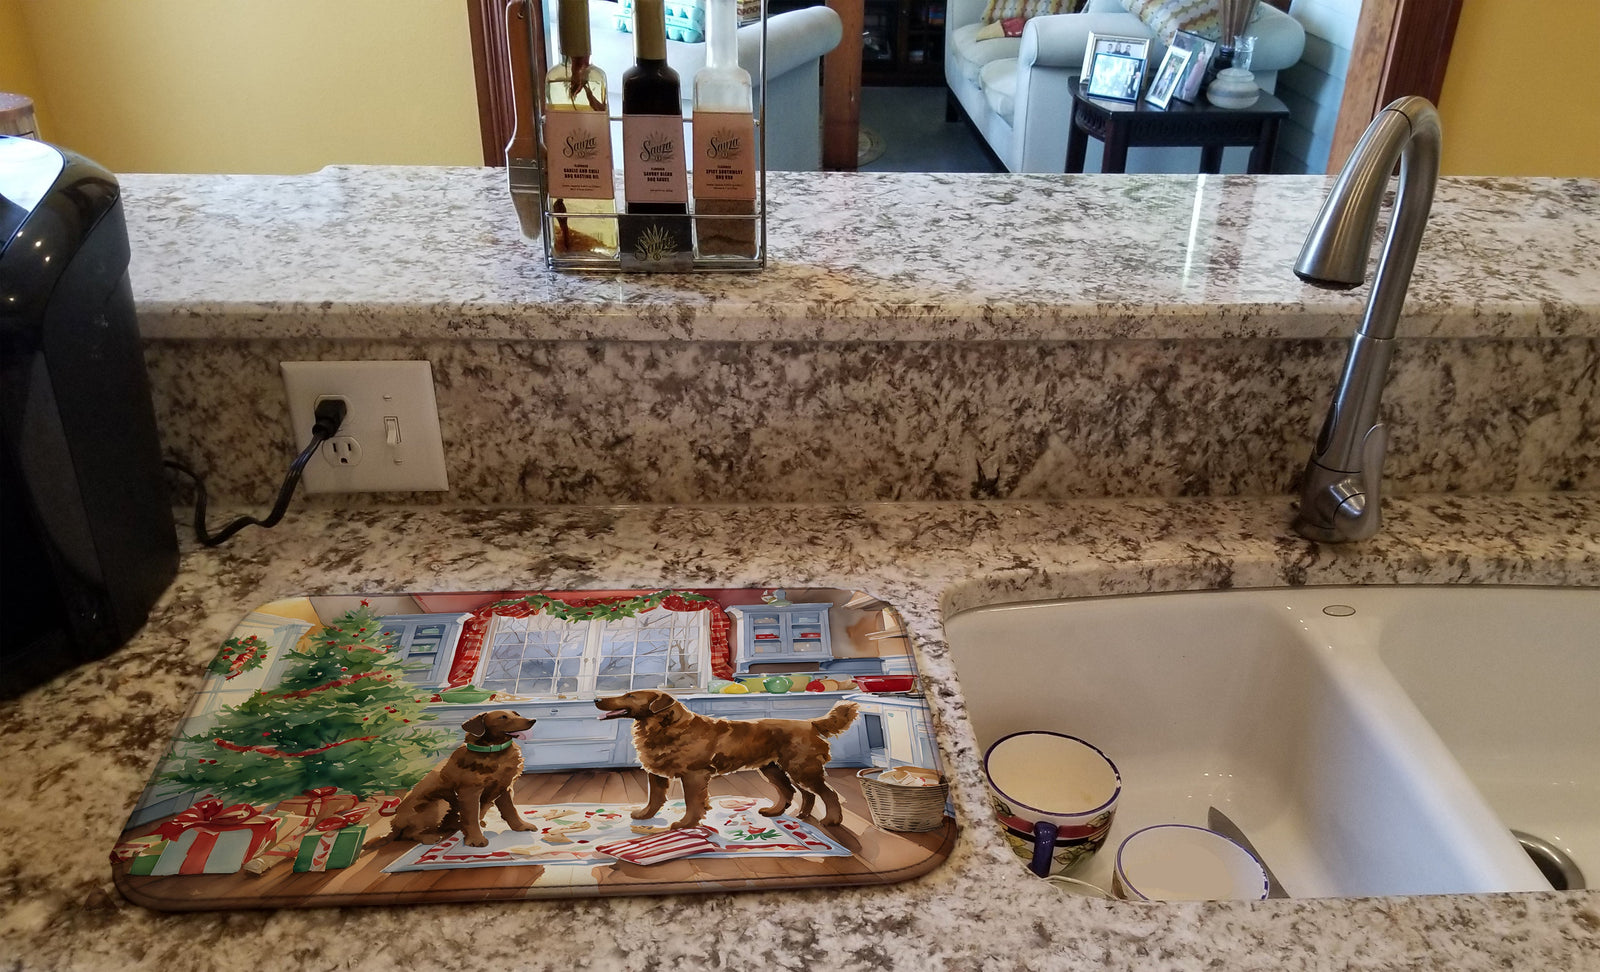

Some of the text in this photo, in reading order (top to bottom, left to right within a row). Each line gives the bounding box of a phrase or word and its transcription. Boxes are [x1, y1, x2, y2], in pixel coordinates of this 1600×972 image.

[563, 136, 597, 158] Sauza
[640, 140, 674, 161] Sauza
[707, 137, 740, 158] Sauza
